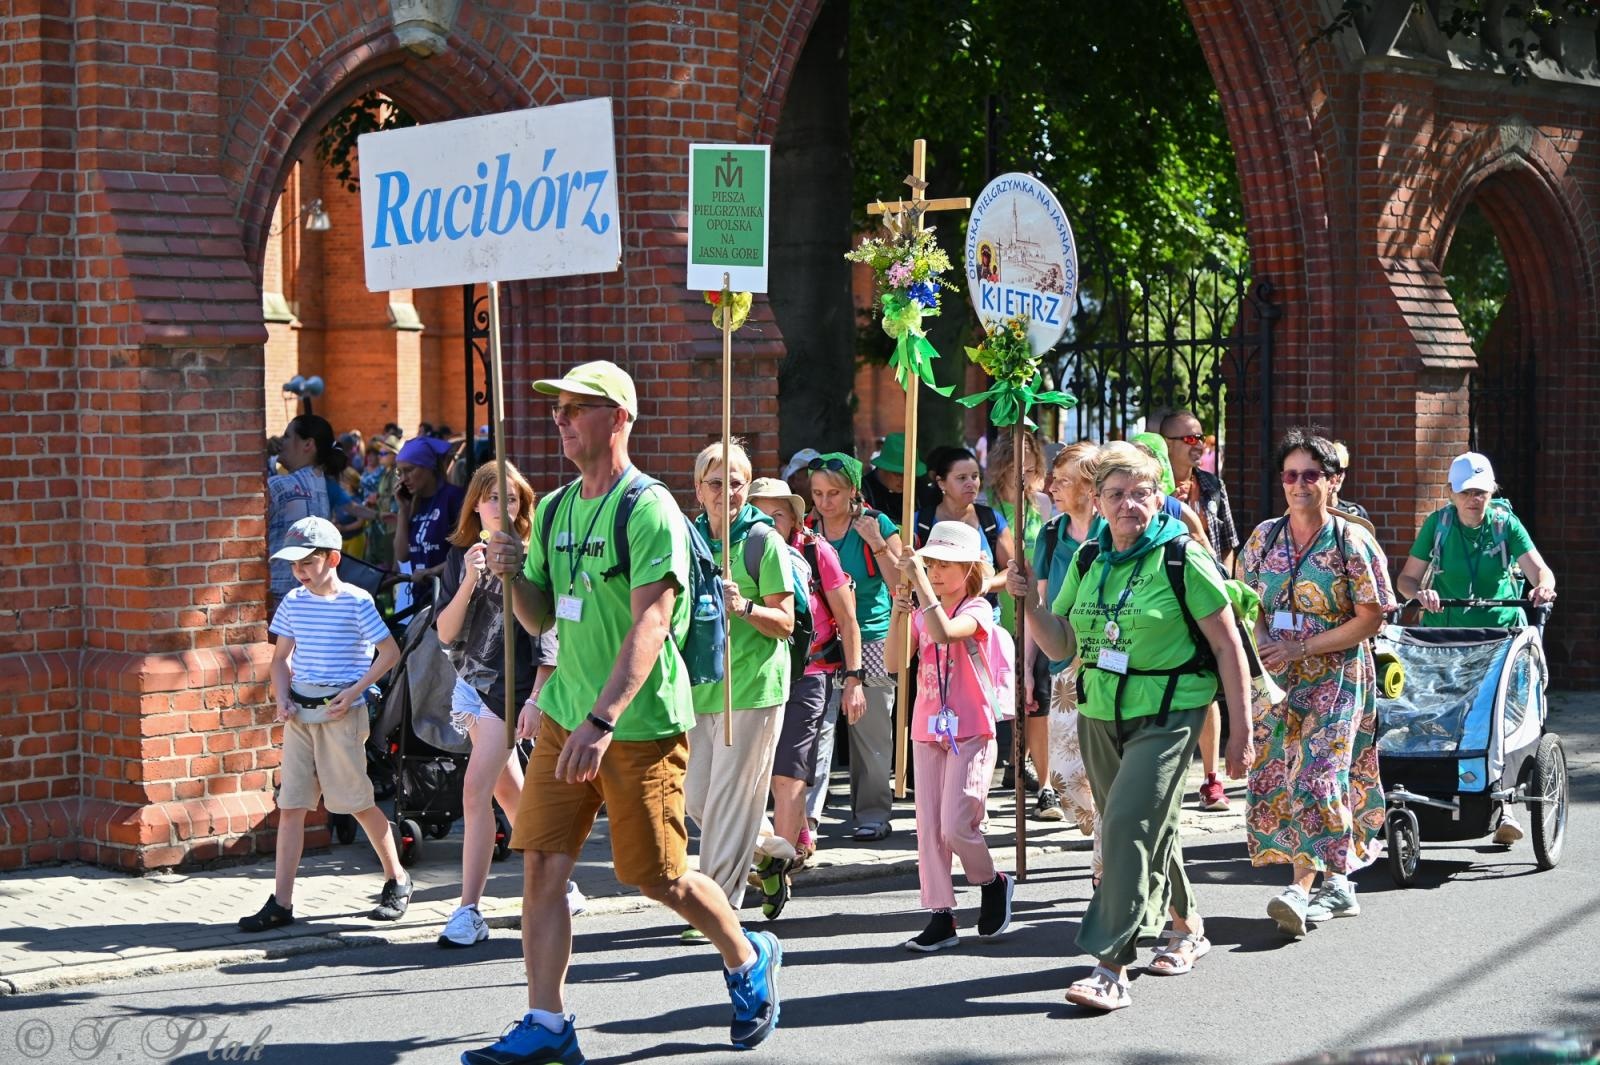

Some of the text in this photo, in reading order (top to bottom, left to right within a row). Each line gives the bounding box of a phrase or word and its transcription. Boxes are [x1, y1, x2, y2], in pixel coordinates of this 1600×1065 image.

[371, 148, 610, 249] Racibórz
[712, 191, 745, 203] PIESZA
[694, 204, 764, 217] PIELGRZYMKA
[706, 219, 752, 231] OPOLSKA
[968, 217, 981, 280] OPOLSKA
[977, 179, 1035, 216] PIELGRZYMKA
[1036, 190, 1051, 212] NA
[721, 233, 735, 245] NA
[981, 284, 1060, 325] KIETRZ
